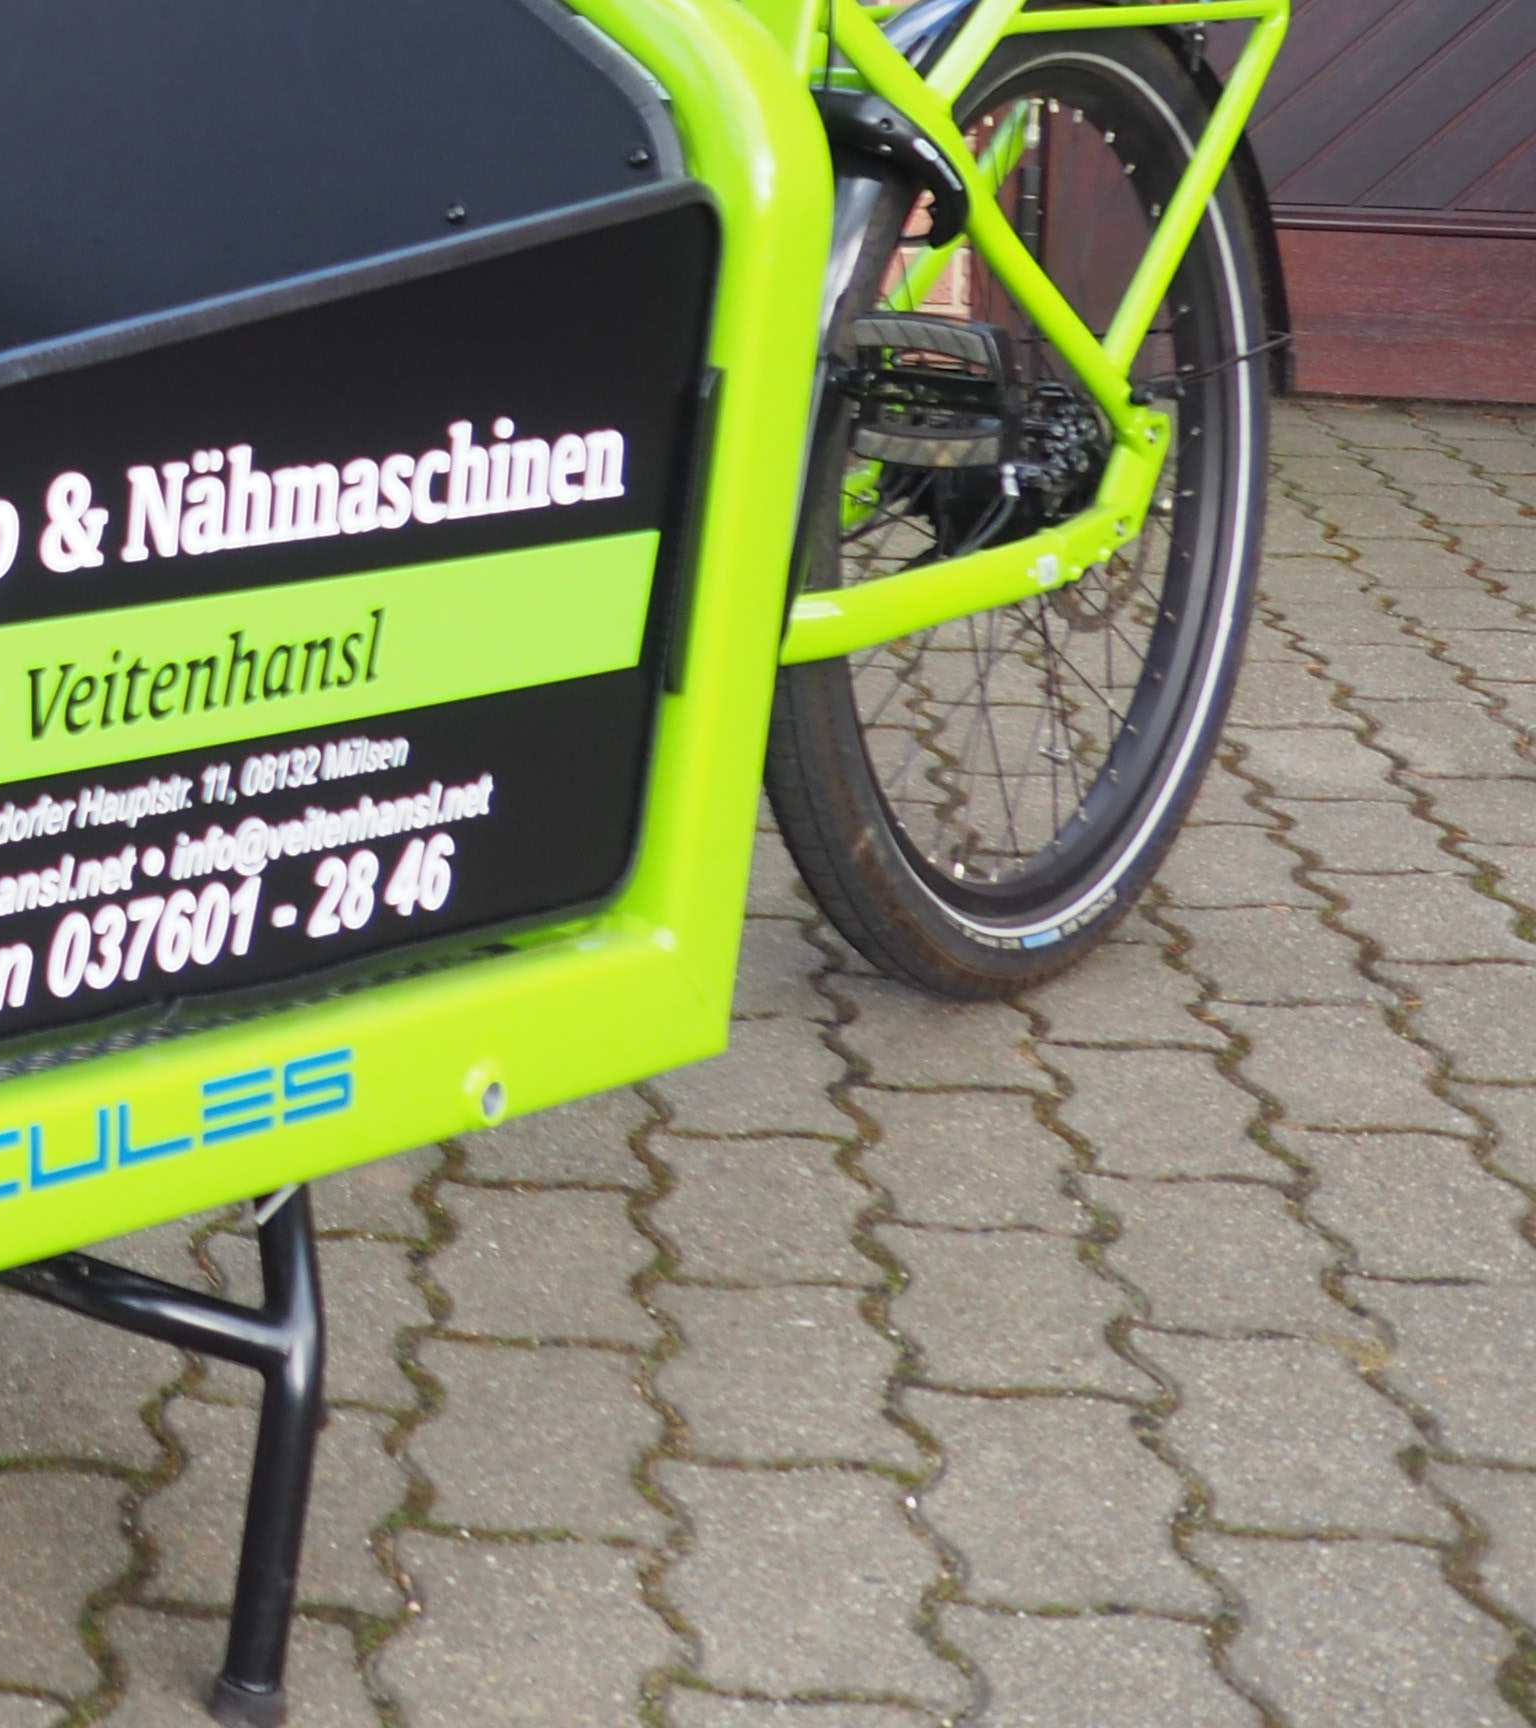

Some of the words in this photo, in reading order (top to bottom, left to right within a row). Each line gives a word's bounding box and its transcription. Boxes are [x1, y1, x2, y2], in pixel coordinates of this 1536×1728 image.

[39, 472, 109, 573] &
[121, 417, 625, 563] Nähmaschinen
[27, 608, 386, 741] Veitenhansl
[76, 774, 193, 828] Hauptstr.
[201, 762, 237, 805] 11,
[240, 746, 322, 798] 08132
[322, 736, 410, 781] Mülsen
[170, 772, 494, 880] info@veitenhansl.net
[46, 875, 262, 999] 037601
[305, 849, 380, 938] 28
[384, 832, 456, 917] 46
